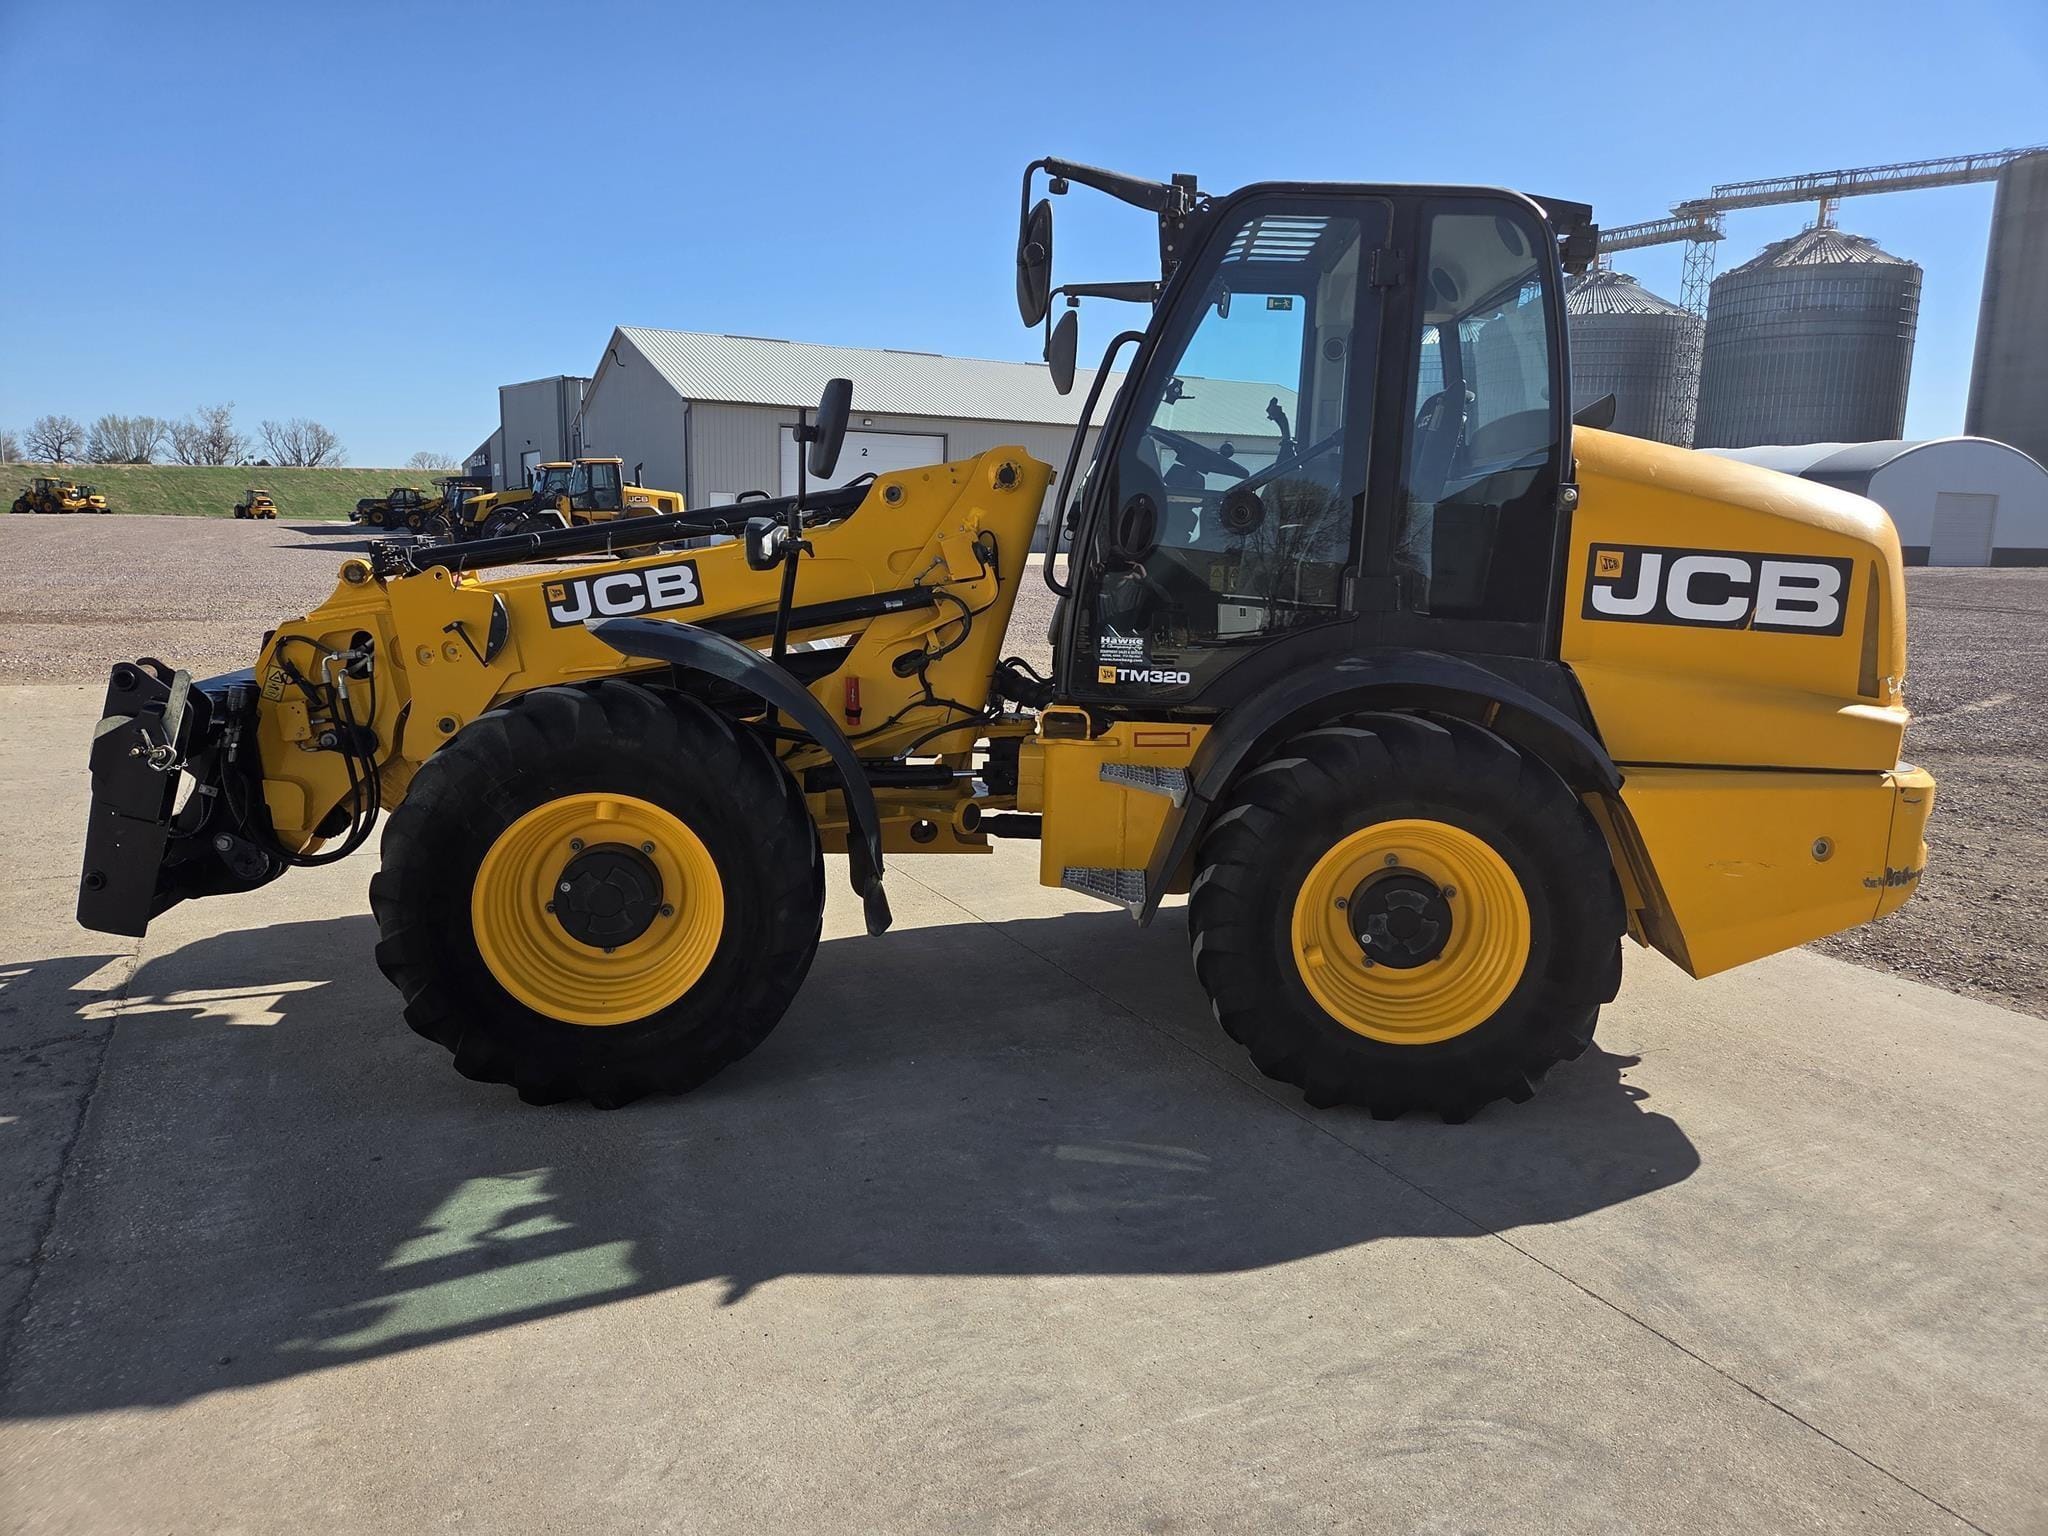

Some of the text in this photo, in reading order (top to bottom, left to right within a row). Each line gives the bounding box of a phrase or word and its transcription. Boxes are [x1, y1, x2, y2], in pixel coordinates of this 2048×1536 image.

[861, 447, 868, 457] 2
[551, 565, 698, 623] JCB
[1591, 553, 1842, 627] JCB
[1100, 636, 1144, 645] Hawke
[1116, 668, 1191, 684] TM320
